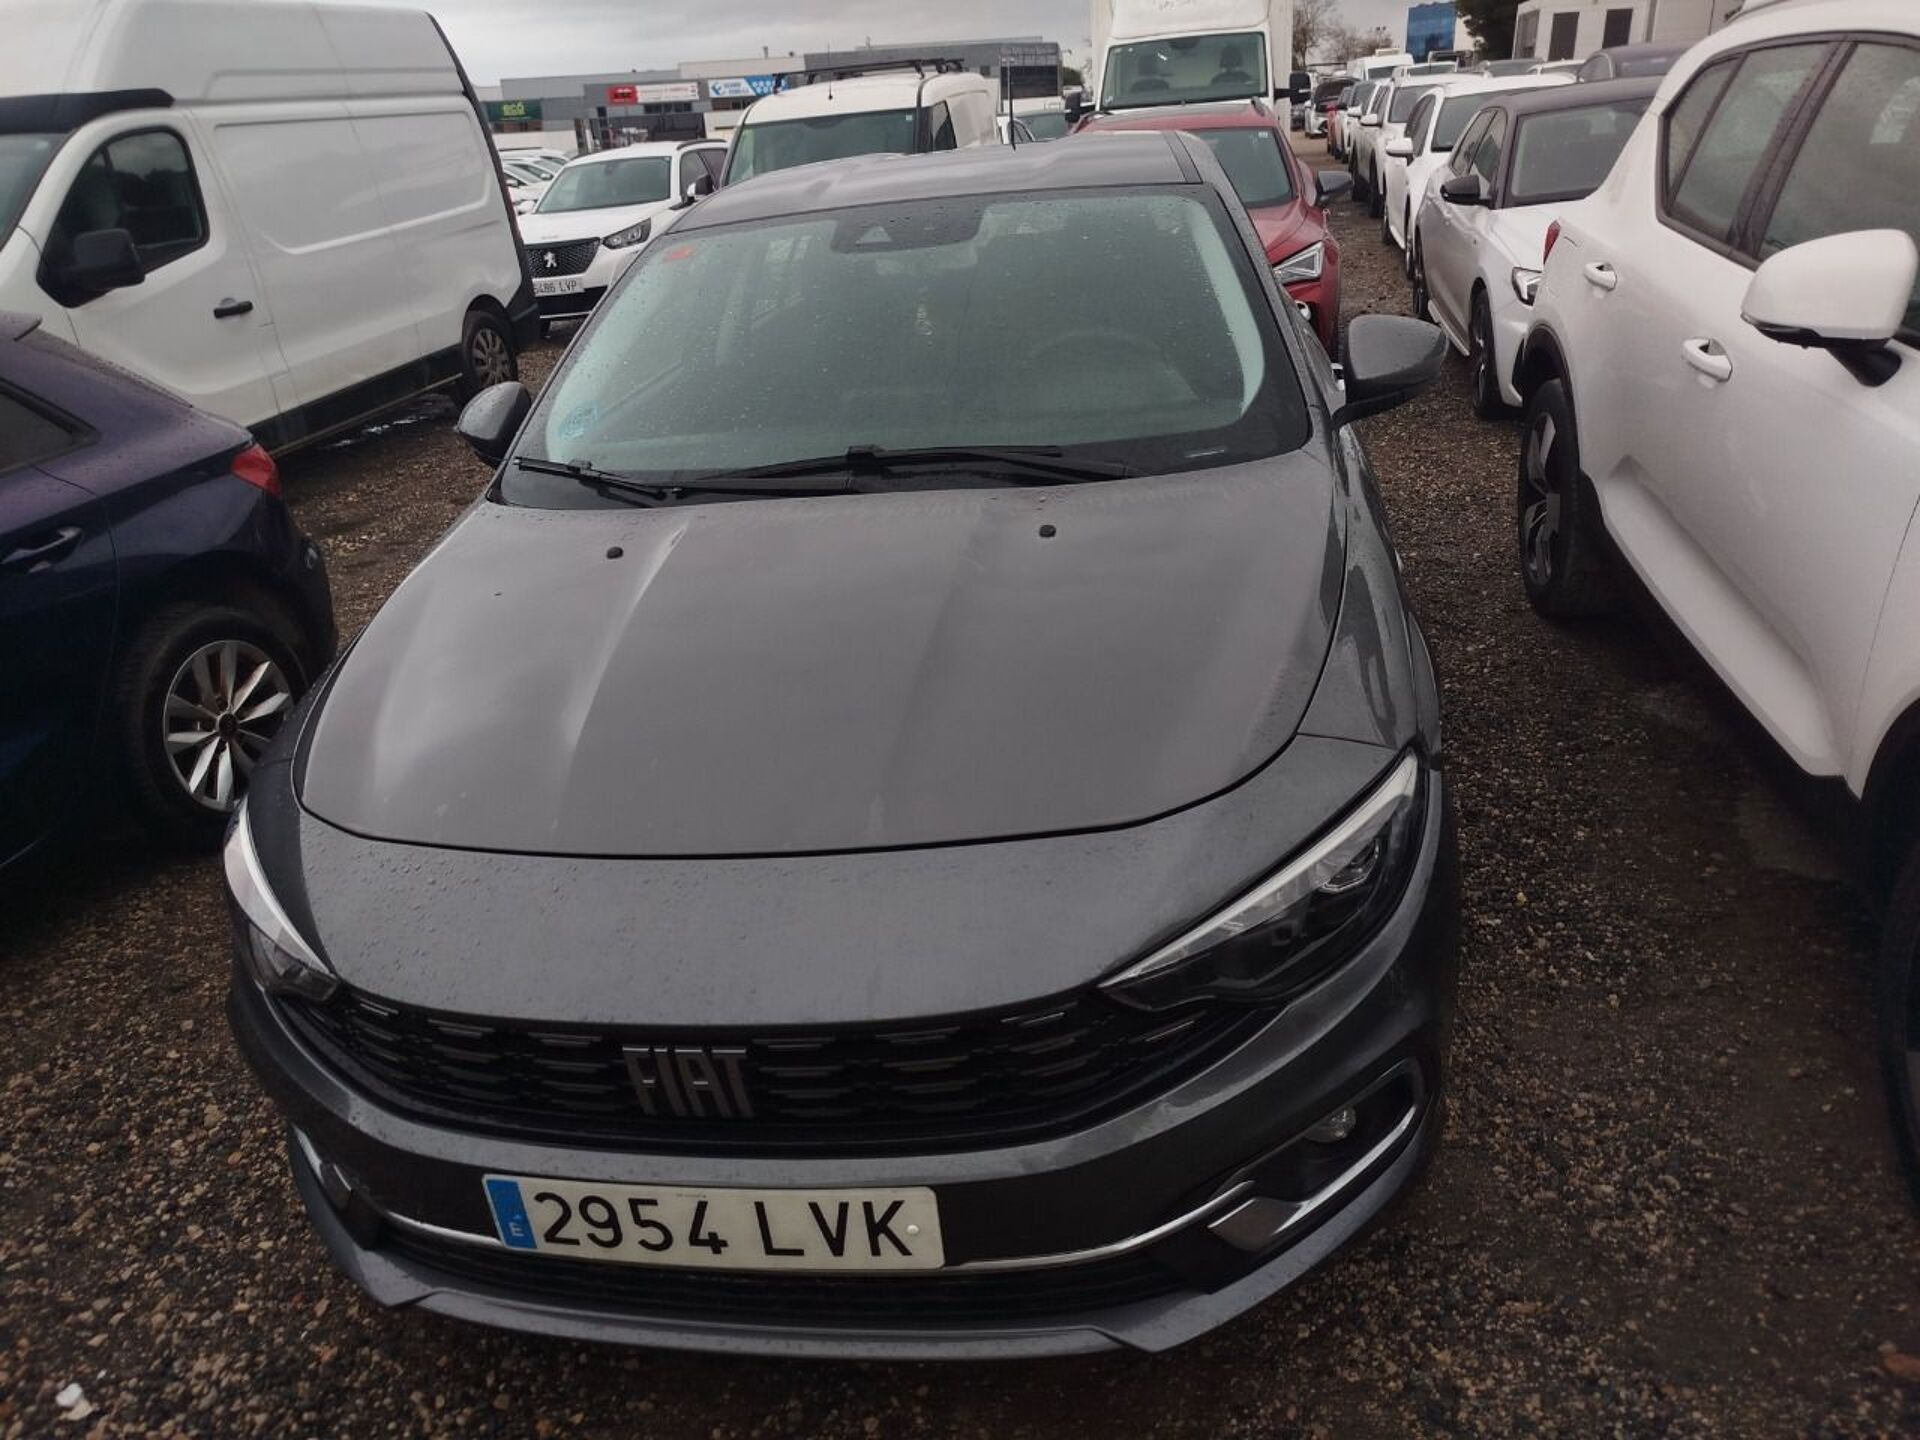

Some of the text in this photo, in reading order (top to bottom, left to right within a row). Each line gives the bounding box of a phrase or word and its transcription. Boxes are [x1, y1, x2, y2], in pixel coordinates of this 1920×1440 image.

[622, 1045, 754, 1119] FIAT
[534, 1191, 913, 1257] 2954 LVK
